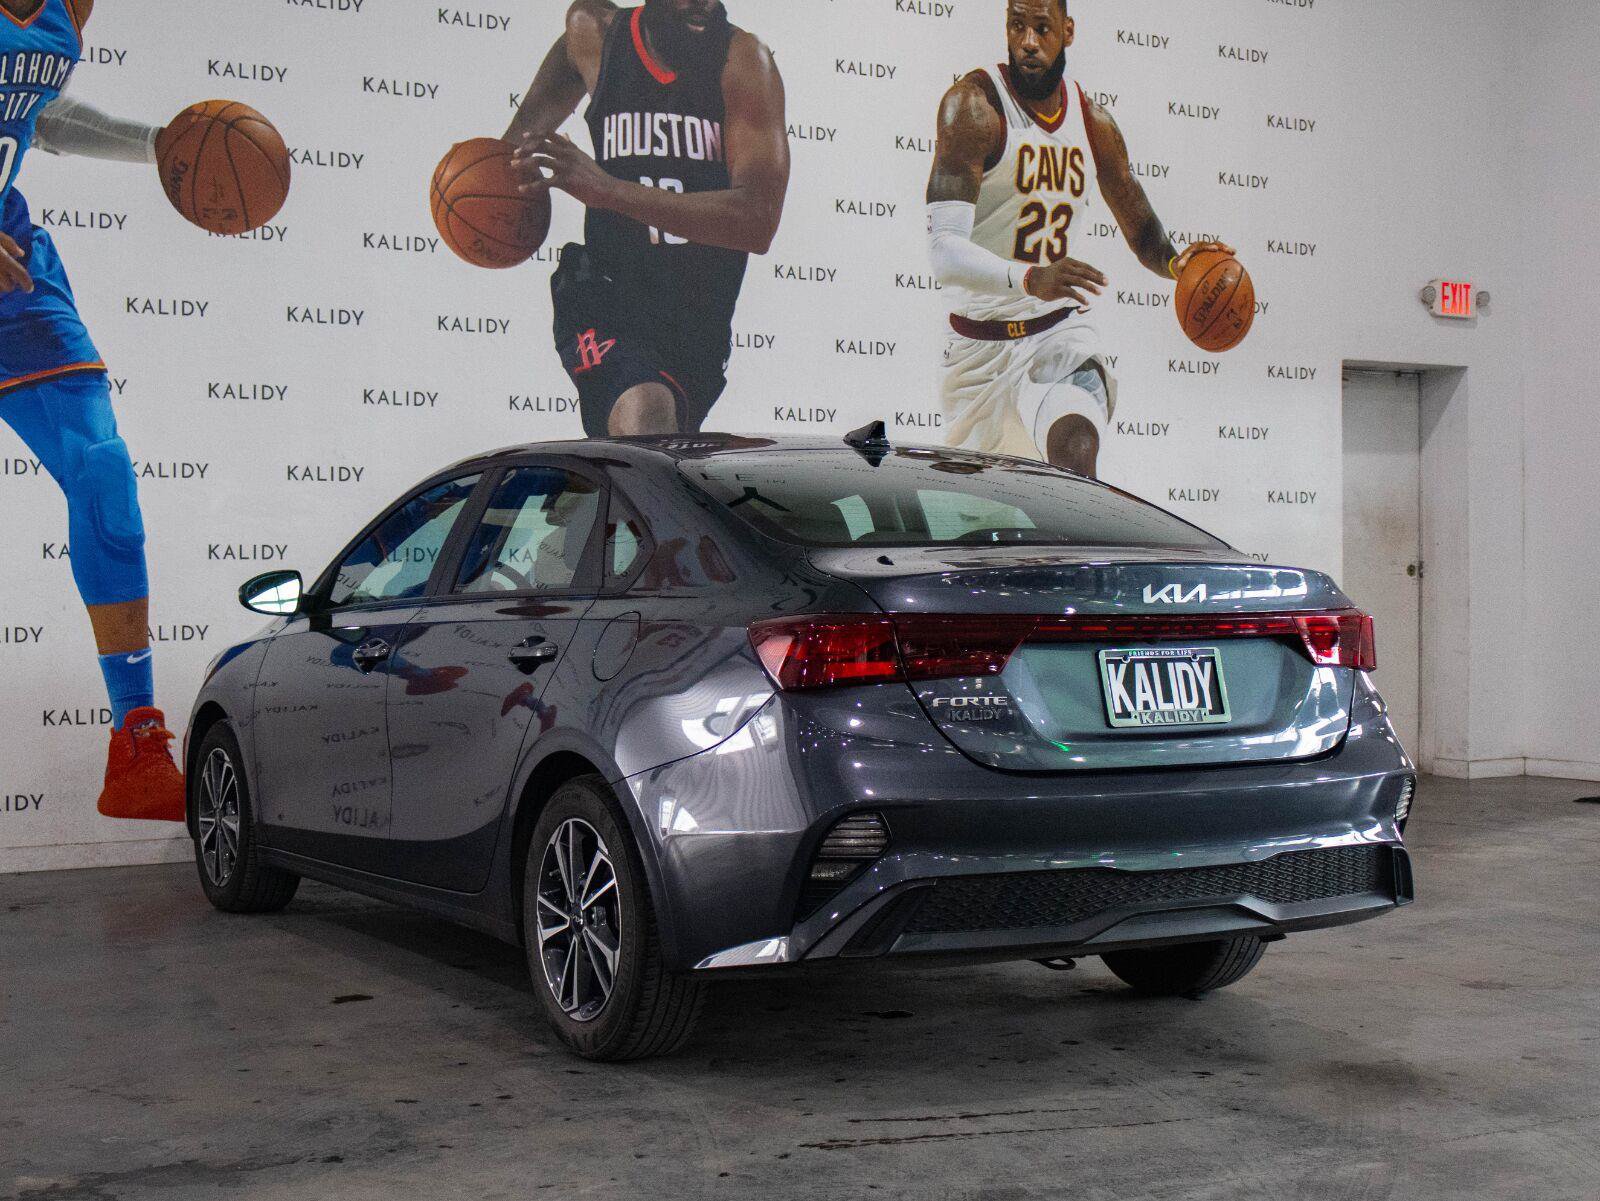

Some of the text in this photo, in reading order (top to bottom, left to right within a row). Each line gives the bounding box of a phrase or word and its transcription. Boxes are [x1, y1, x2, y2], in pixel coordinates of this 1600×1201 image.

[895, 0, 954, 18] KALIDY
[438, 8, 511, 31] KALIDY
[1117, 29, 1170, 49] KALIDY
[79, 46, 128, 66] IDY
[1218, 45, 1269, 64] KALIDY
[208, 59, 288, 83] KALIDY
[836, 59, 896, 80] KALIDY
[363, 76, 439, 99] KALIDY
[1168, 102, 1220, 120] KALIDY
[787, 124, 837, 142] ALIDY
[1267, 115, 1316, 133] KALIDY
[603, 112, 722, 161] HOUSTON
[895, 136, 936, 153] KALI
[1015, 143, 1085, 197] CAVS
[1129, 162, 1170, 178] ALIDY
[1218, 171, 1269, 190] KALIDY
[835, 199, 896, 217] KALIDY
[42, 209, 128, 231] KALIDY
[1012, 200, 1074, 264] 23
[363, 233, 439, 254] KALIDY
[1267, 240, 1317, 256] KALIDY
[774, 264, 837, 282] KALIDY
[126, 297, 209, 318] KALIDY
[1117, 291, 1170, 308] KALIDY
[1441, 282, 1471, 316] EXIT
[287, 307, 364, 327] KALIDY
[438, 315, 510, 335] KALIDY
[1007, 321, 1027, 338] CLE
[730, 333, 775, 349] LIDY
[835, 339, 896, 357] KALIDY
[1168, 360, 1220, 374] KALIDY
[1267, 366, 1317, 380] KALIDY
[208, 383, 288, 401] KALIDY
[363, 389, 439, 407] KALIDY
[509, 396, 579, 413] KALIDY
[774, 407, 837, 422] KALIDY
[895, 412, 942, 427] KALID
[1117, 422, 1170, 436] KALIDY
[1218, 425, 1269, 440] KALIDY
[0, 459, 42, 476] IDY
[287, 465, 364, 483] KALIDY
[1168, 488, 1220, 502] KALIDY
[1267, 491, 1317, 504] KALIDY
[208, 544, 288, 561] KALIDY
[1143, 584, 1206, 603] KIA
[0, 627, 44, 643] IDY
[146, 625, 209, 641] ALIDY
[1107, 662, 1213, 714] KALIDY
[932, 696, 1008, 708] FORTE
[43, 708, 113, 726] KALID
[951, 708, 1002, 721] KALIDY
[1141, 710, 1199, 724] KALIDY
[0, 794, 45, 812] IDY
